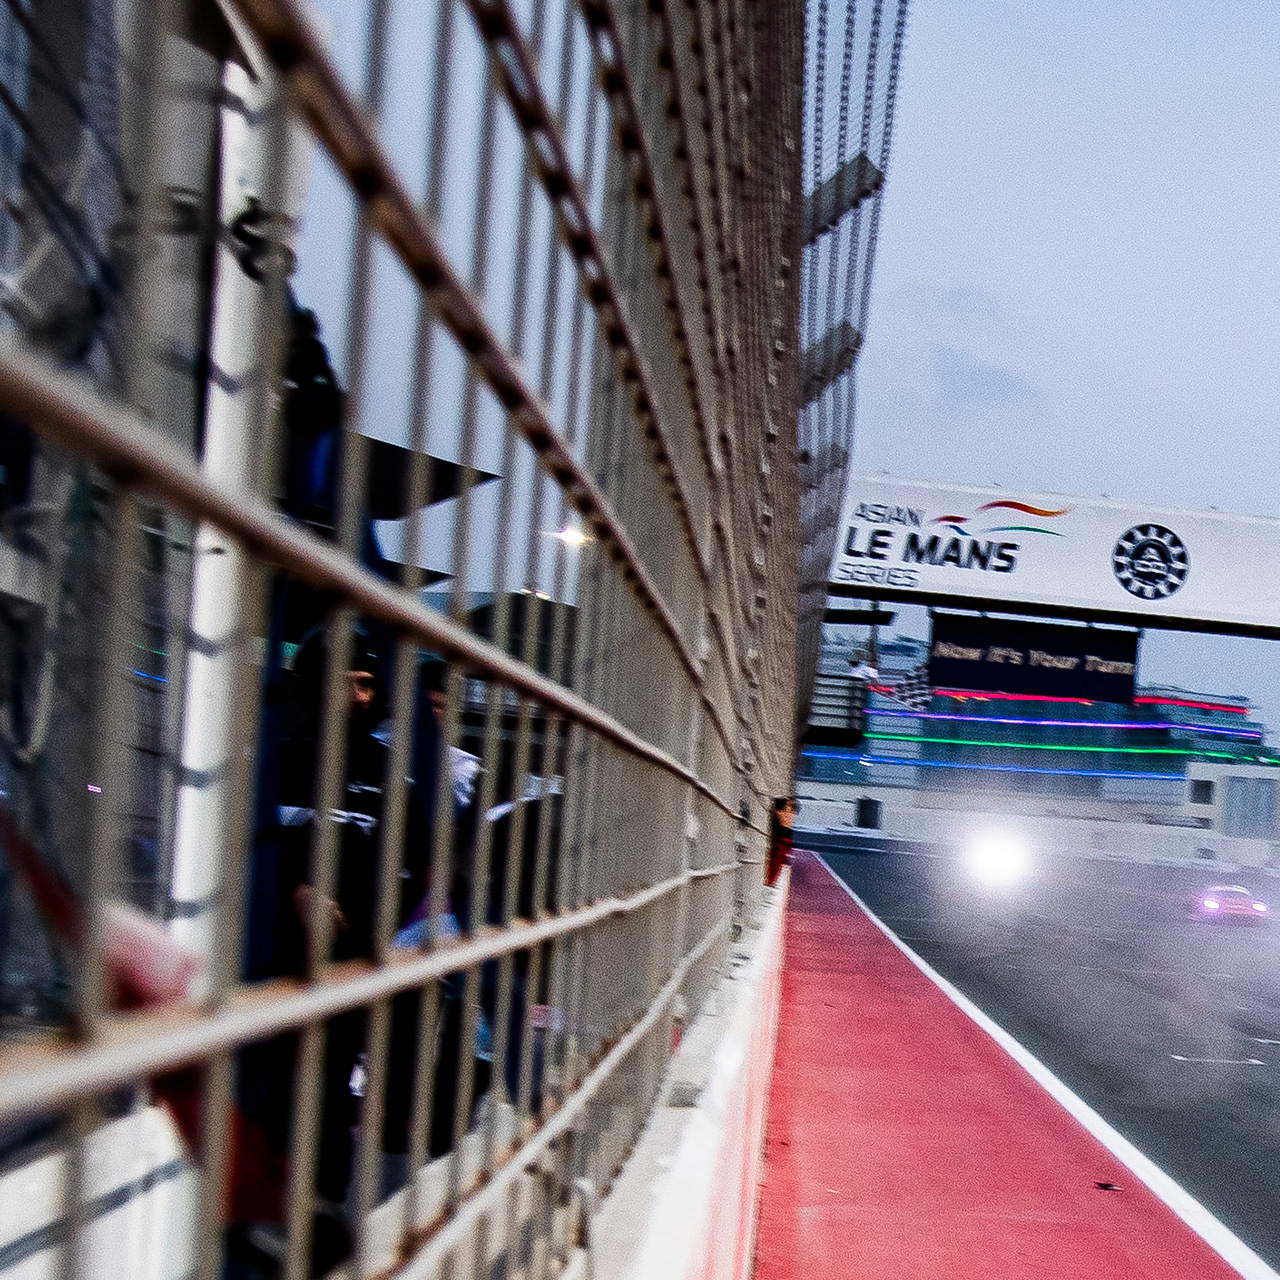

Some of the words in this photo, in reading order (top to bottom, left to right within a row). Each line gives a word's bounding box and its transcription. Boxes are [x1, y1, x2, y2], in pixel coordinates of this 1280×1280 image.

[843, 525, 894, 561] LE
[901, 531, 1021, 574] MANS
[836, 562, 920, 588] SERIES
